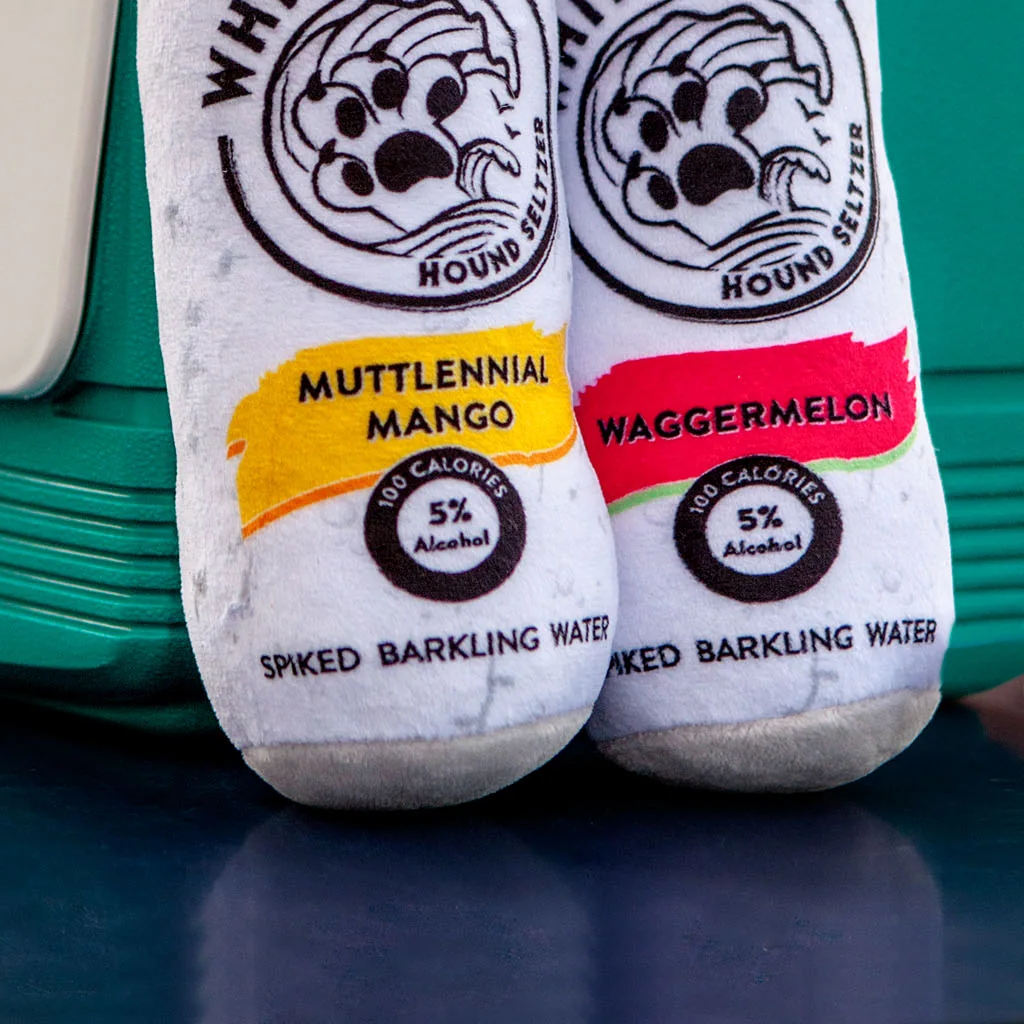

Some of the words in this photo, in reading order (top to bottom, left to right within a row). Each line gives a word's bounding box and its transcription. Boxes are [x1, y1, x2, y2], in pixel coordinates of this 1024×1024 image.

[418, 237, 521, 288] HOUND
[520, 115, 546, 242] SELTZER
[721, 244, 835, 301] HOUND
[832, 122, 864, 247] SELTZER
[298, 354, 550, 404] MUTTLENNIAL
[366, 400, 515, 441] MANGO
[596, 391, 894, 446] WAGGERMELON
[378, 474, 408, 508] 100
[409, 456, 509, 499] CALORIES
[689, 482, 719, 514] 100
[721, 464, 827, 505] CALORIES
[428, 497, 473, 525] 5%
[737, 505, 784, 532] 5%
[413, 529, 491, 554] Alcohol
[723, 534, 803, 558] Alcohol
[260, 646, 362, 679] SPIKED
[378, 625, 541, 668] BARKLING
[550, 614, 610, 647] WATER
[696, 624, 855, 665] BARKLING
[866, 618, 938, 648] WATER
